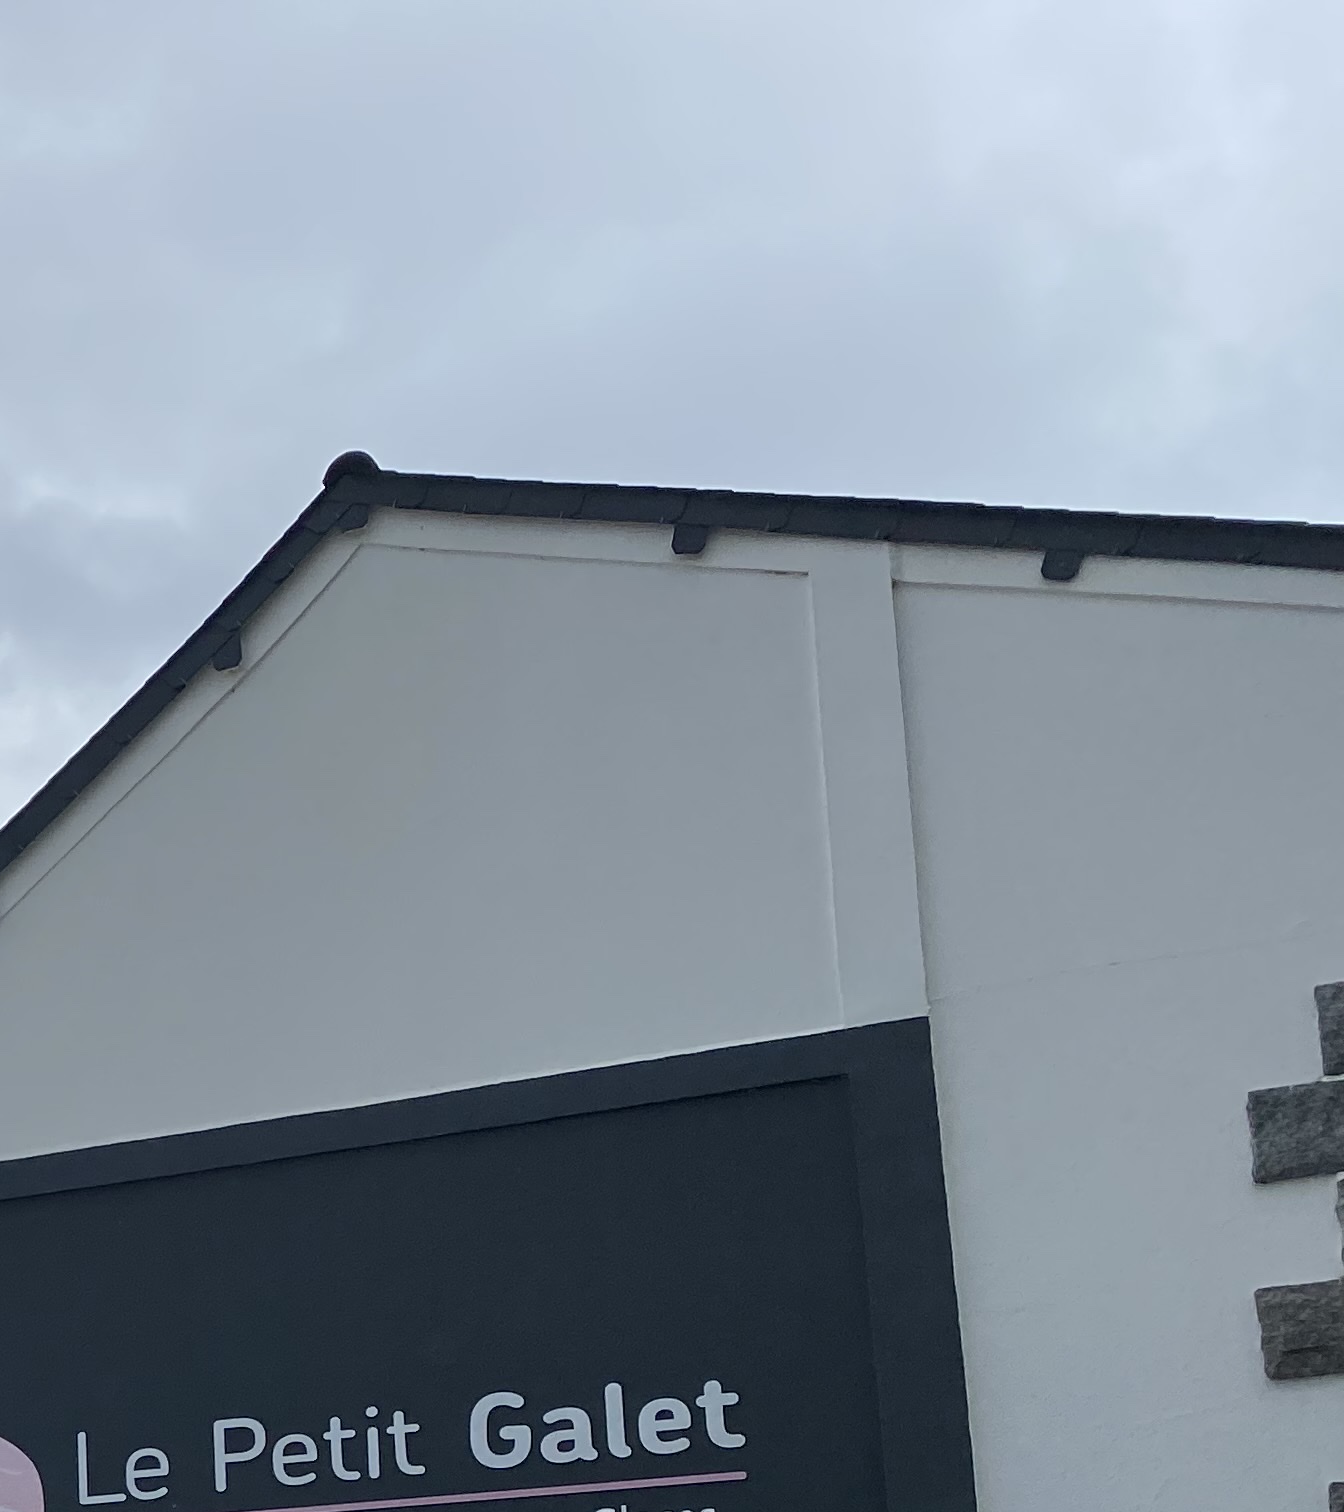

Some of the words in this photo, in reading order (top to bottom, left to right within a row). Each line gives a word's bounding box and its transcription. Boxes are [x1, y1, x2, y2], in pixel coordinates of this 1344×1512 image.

[77, 1431, 170, 1505] Le
[213, 1405, 426, 1493] Petit
[469, 1379, 746, 1469] Galet
